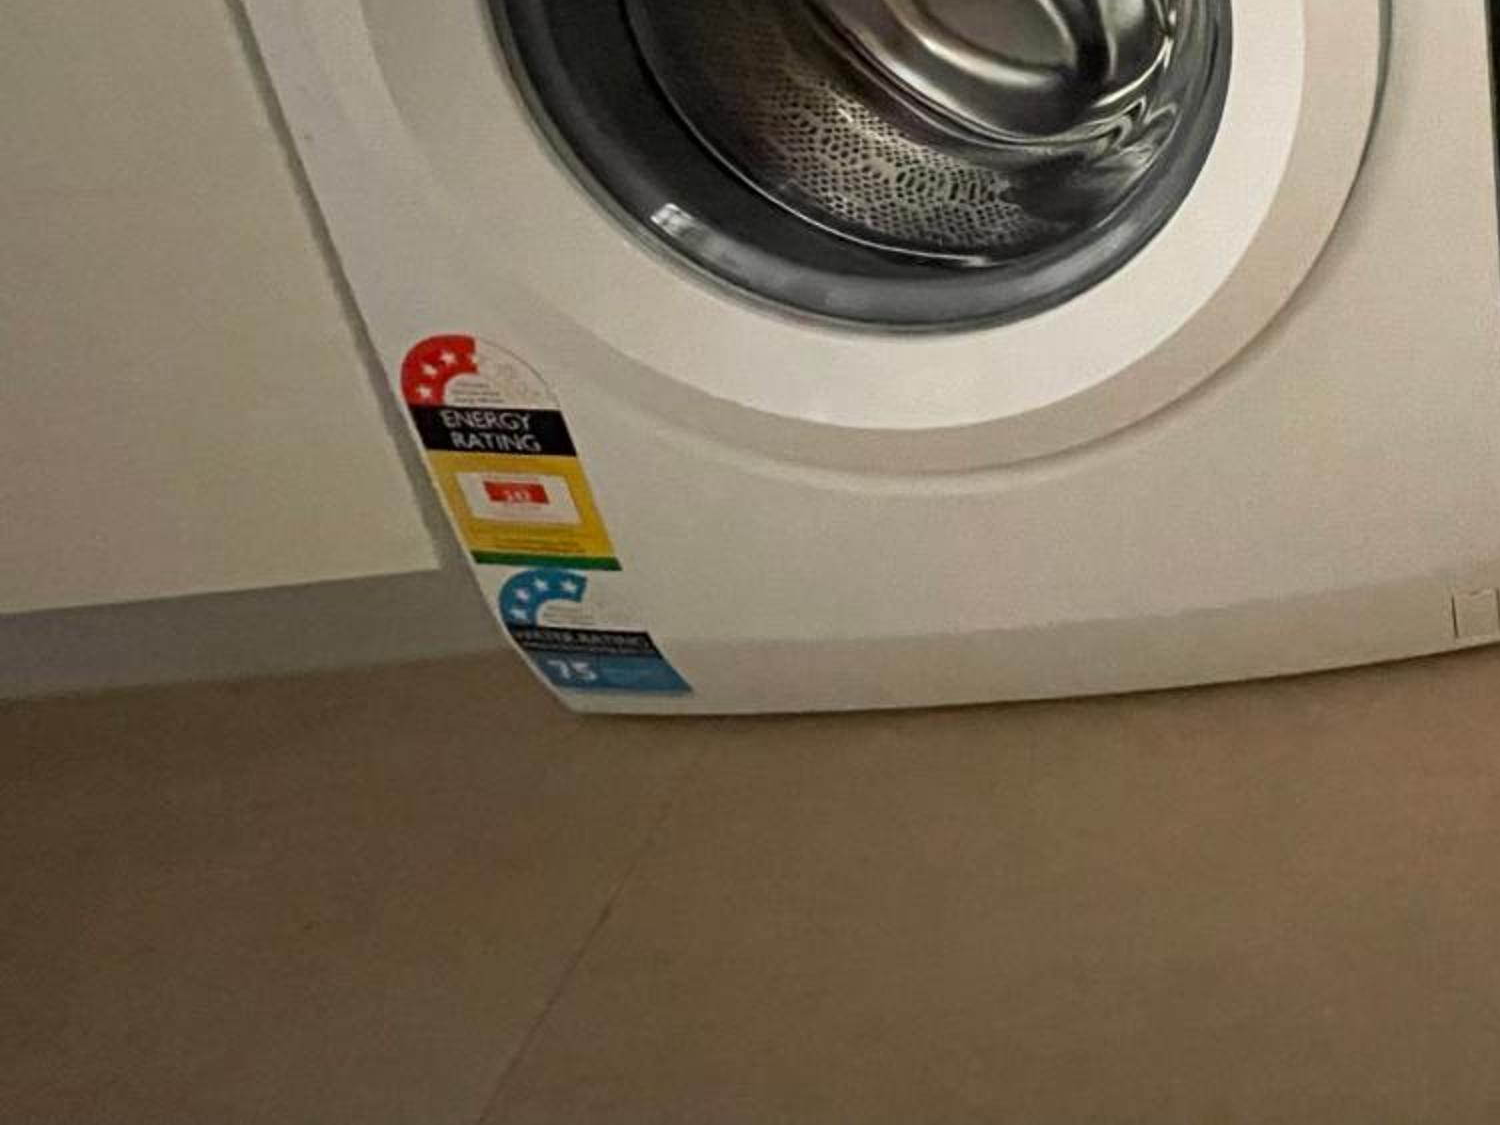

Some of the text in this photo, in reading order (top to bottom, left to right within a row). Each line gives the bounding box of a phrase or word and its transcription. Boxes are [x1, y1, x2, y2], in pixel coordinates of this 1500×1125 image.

[440, 410, 532, 431] ENERGY
[450, 431, 543, 452] RATING
[546, 658, 599, 681] 75
